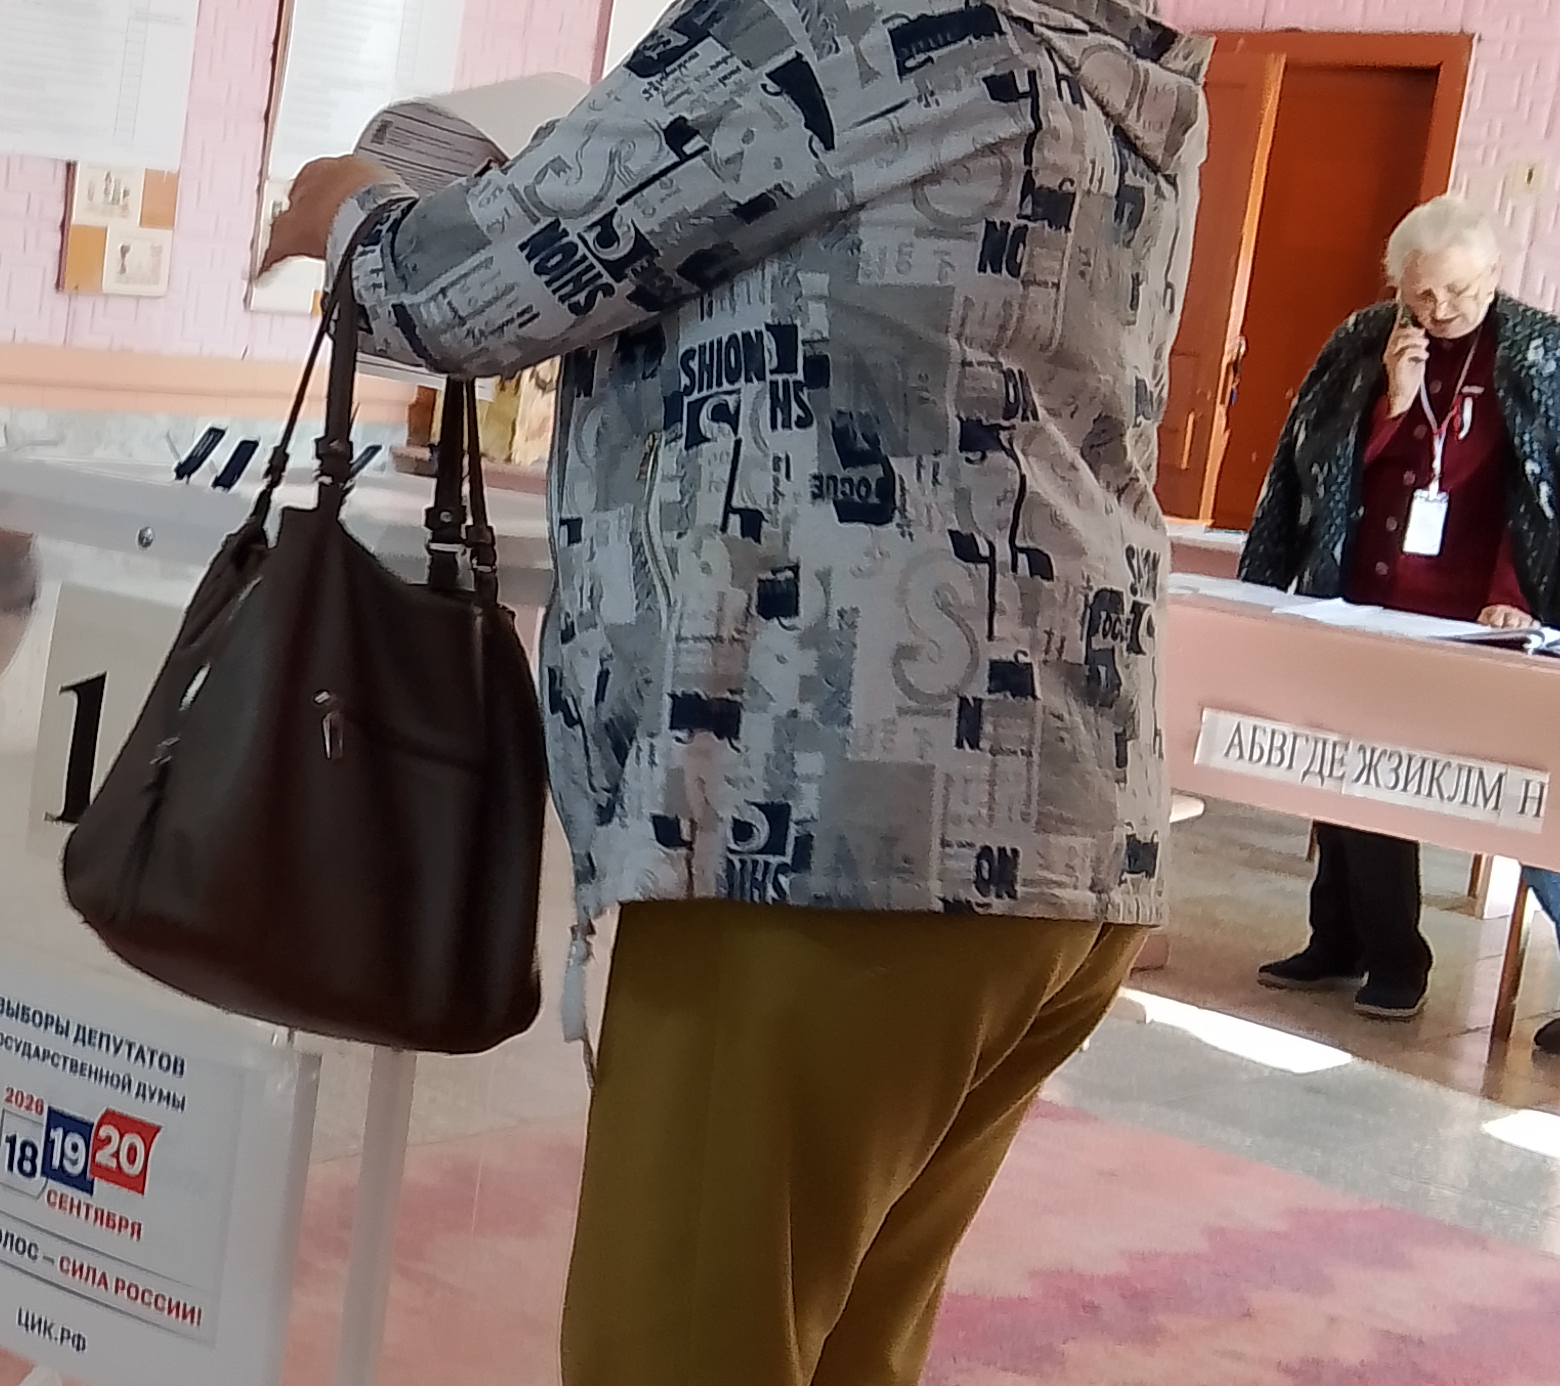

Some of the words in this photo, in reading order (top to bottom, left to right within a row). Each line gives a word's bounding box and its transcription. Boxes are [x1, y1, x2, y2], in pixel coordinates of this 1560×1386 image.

[680, 330, 766, 396] SHION
[73, 1021, 186, 1078] ДЕПУТАТОВ
[135, 1079, 187, 1113] ДУМЫ
[3, 1132, 39, 1179] 18
[49, 1126, 87, 1177] 19
[94, 1125, 146, 1176] 20
[45, 1189, 143, 1241] СЕНТЯБРЯ
[58, 1255, 109, 1291] СИЛА
[114, 1277, 202, 1326] РОССИИ!
[16, 1306, 87, 1353] ЦИК.РФ
